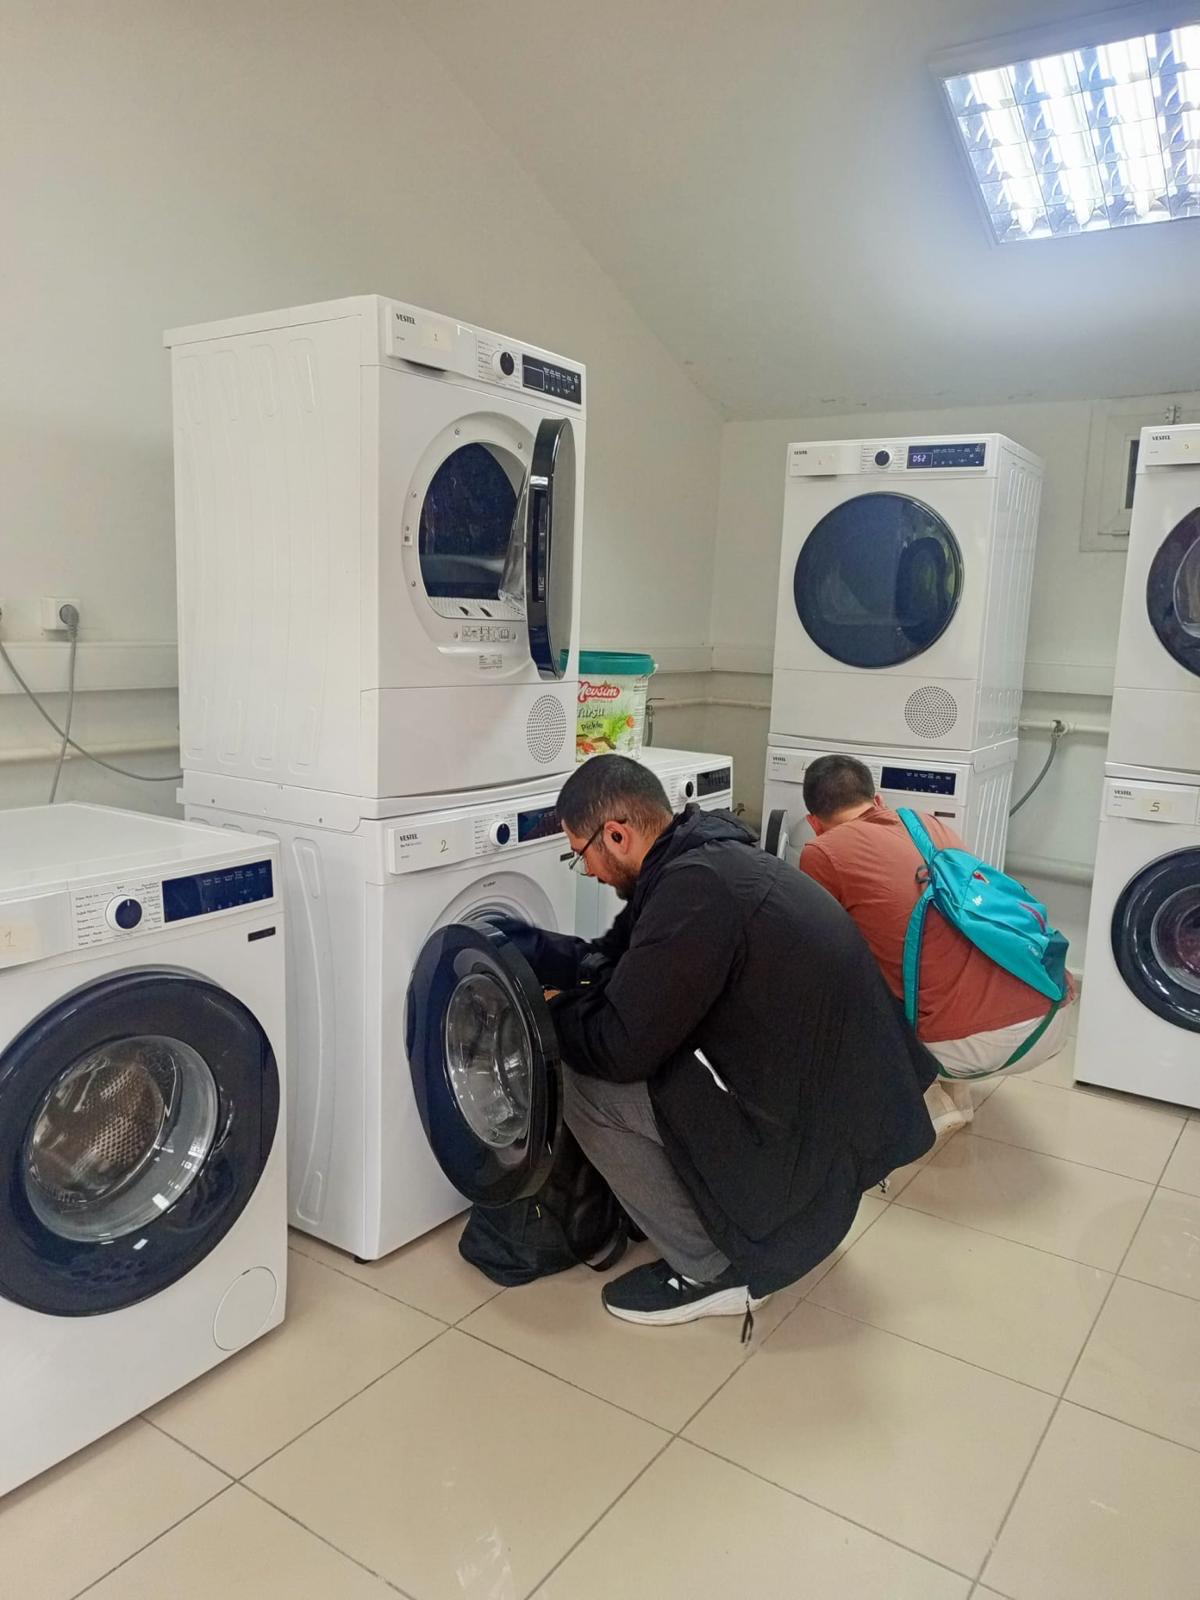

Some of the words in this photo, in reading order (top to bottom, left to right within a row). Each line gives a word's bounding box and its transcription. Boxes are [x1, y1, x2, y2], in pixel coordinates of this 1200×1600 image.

[395, 313, 416, 326] VESTEL
[578, 680, 620, 702] Mevsim
[399, 833, 419, 842] VESTEL
[439, 839, 450, 853] 2
